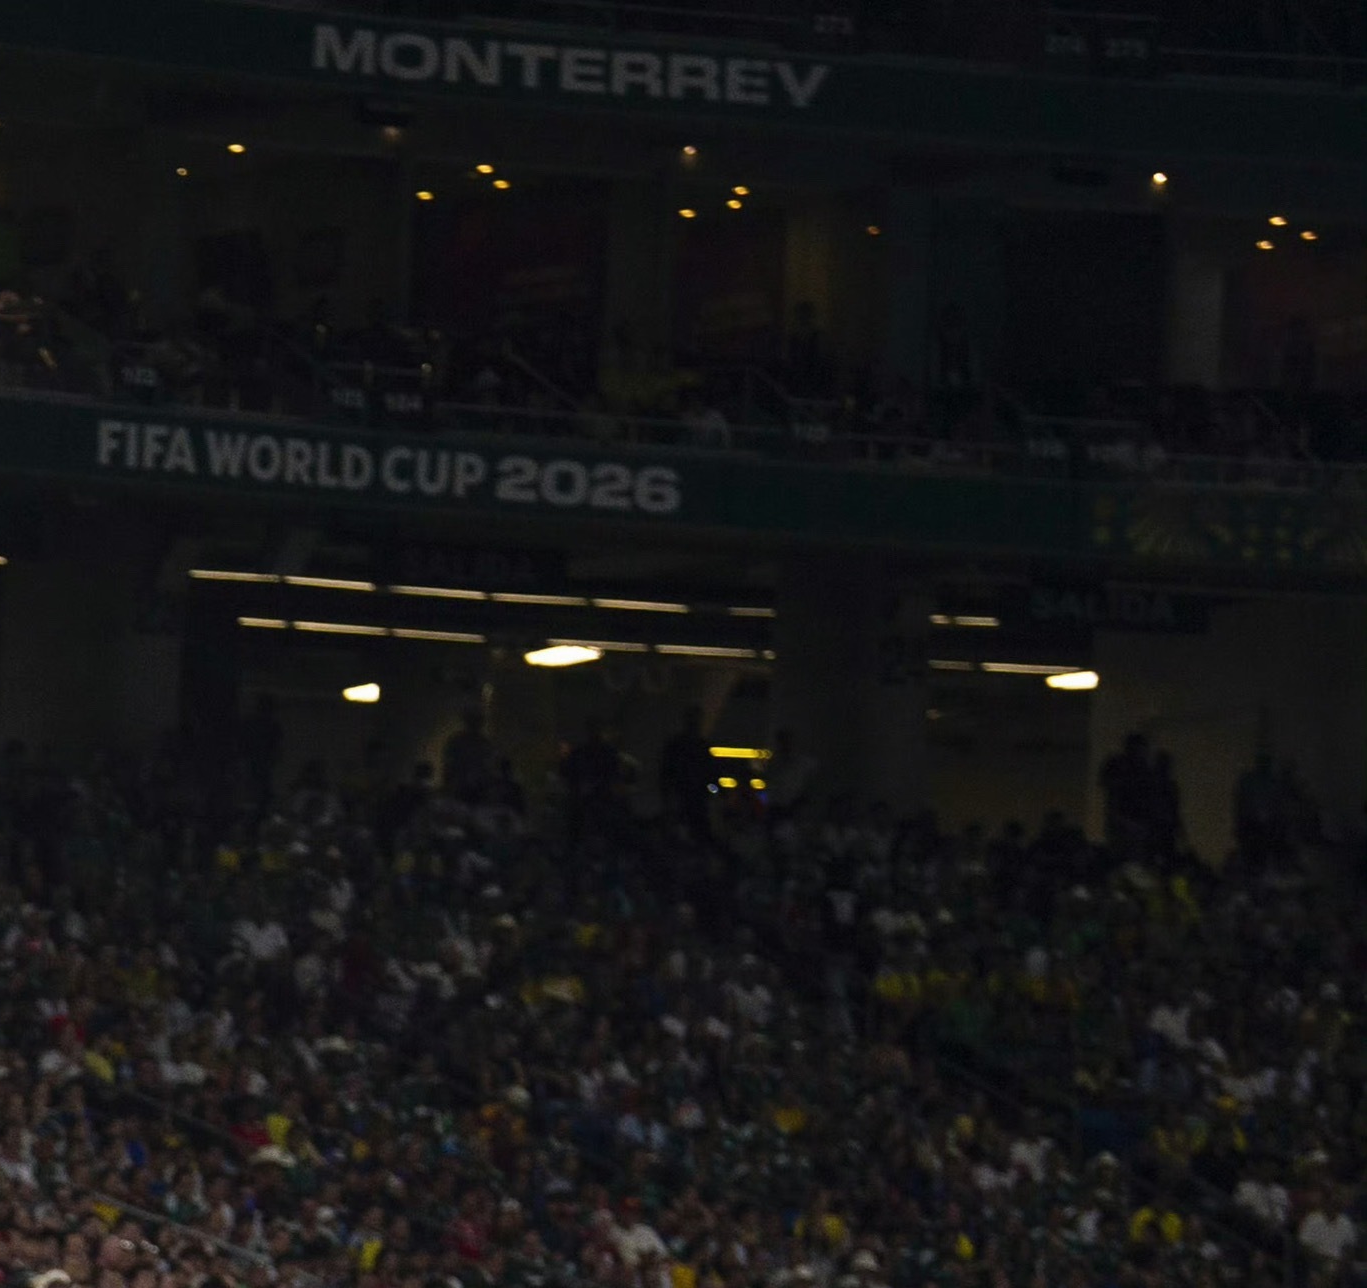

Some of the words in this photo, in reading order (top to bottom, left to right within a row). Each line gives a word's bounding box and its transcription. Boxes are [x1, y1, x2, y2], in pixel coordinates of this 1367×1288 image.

[312, 24, 830, 107] MONTERREY
[96, 419, 197, 476] FIFA
[203, 429, 374, 491] WORLD
[379, 446, 485, 498] CUP
[494, 455, 680, 512] 2026
[1030, 588, 1176, 626] SALIDA
